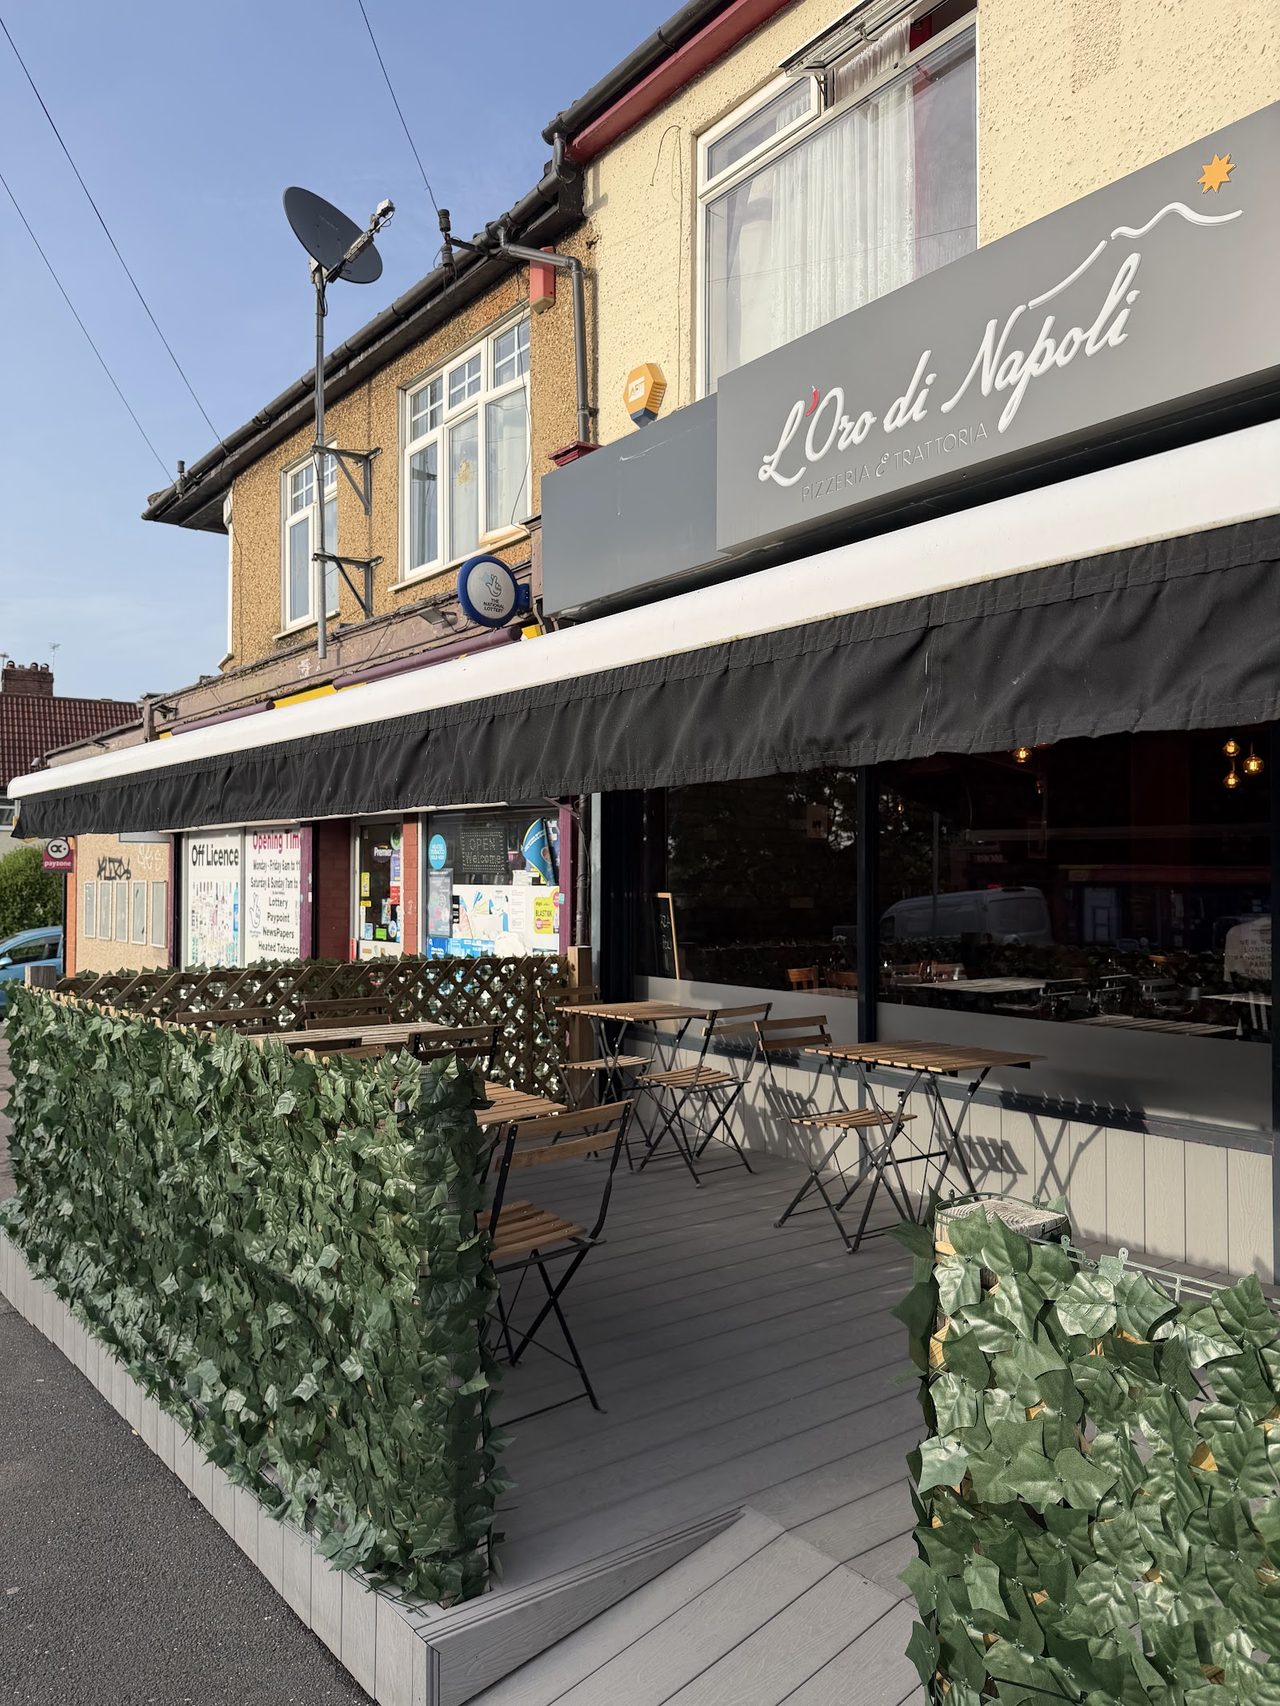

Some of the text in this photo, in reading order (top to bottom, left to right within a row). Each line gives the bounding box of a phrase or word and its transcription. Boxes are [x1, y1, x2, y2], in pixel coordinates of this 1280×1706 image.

[758, 252, 1141, 487] L'Oro di Napoli
[800, 464, 870, 502] PIZZERIA
[894, 423, 988, 469] TRATTORIA
[483, 601, 504, 610] NATIONAL
[252, 831, 300, 854] Opening Tim
[469, 838, 496, 850] OPEN
[191, 843, 205, 866] Off
[206, 843, 239, 866] Licence
[465, 851, 501, 864] Welcome
[253, 860, 267, 873] Monday
[270, 860, 281, 873] Friday
[250, 877, 267, 890] Saturday
[271, 877, 284, 890] Sunday
[269, 896, 288, 909] Lottery
[267, 911, 289, 923] Paypoint
[262, 926, 294, 940] NewsPapers
[258, 941, 299, 955] Heated Tobacco
